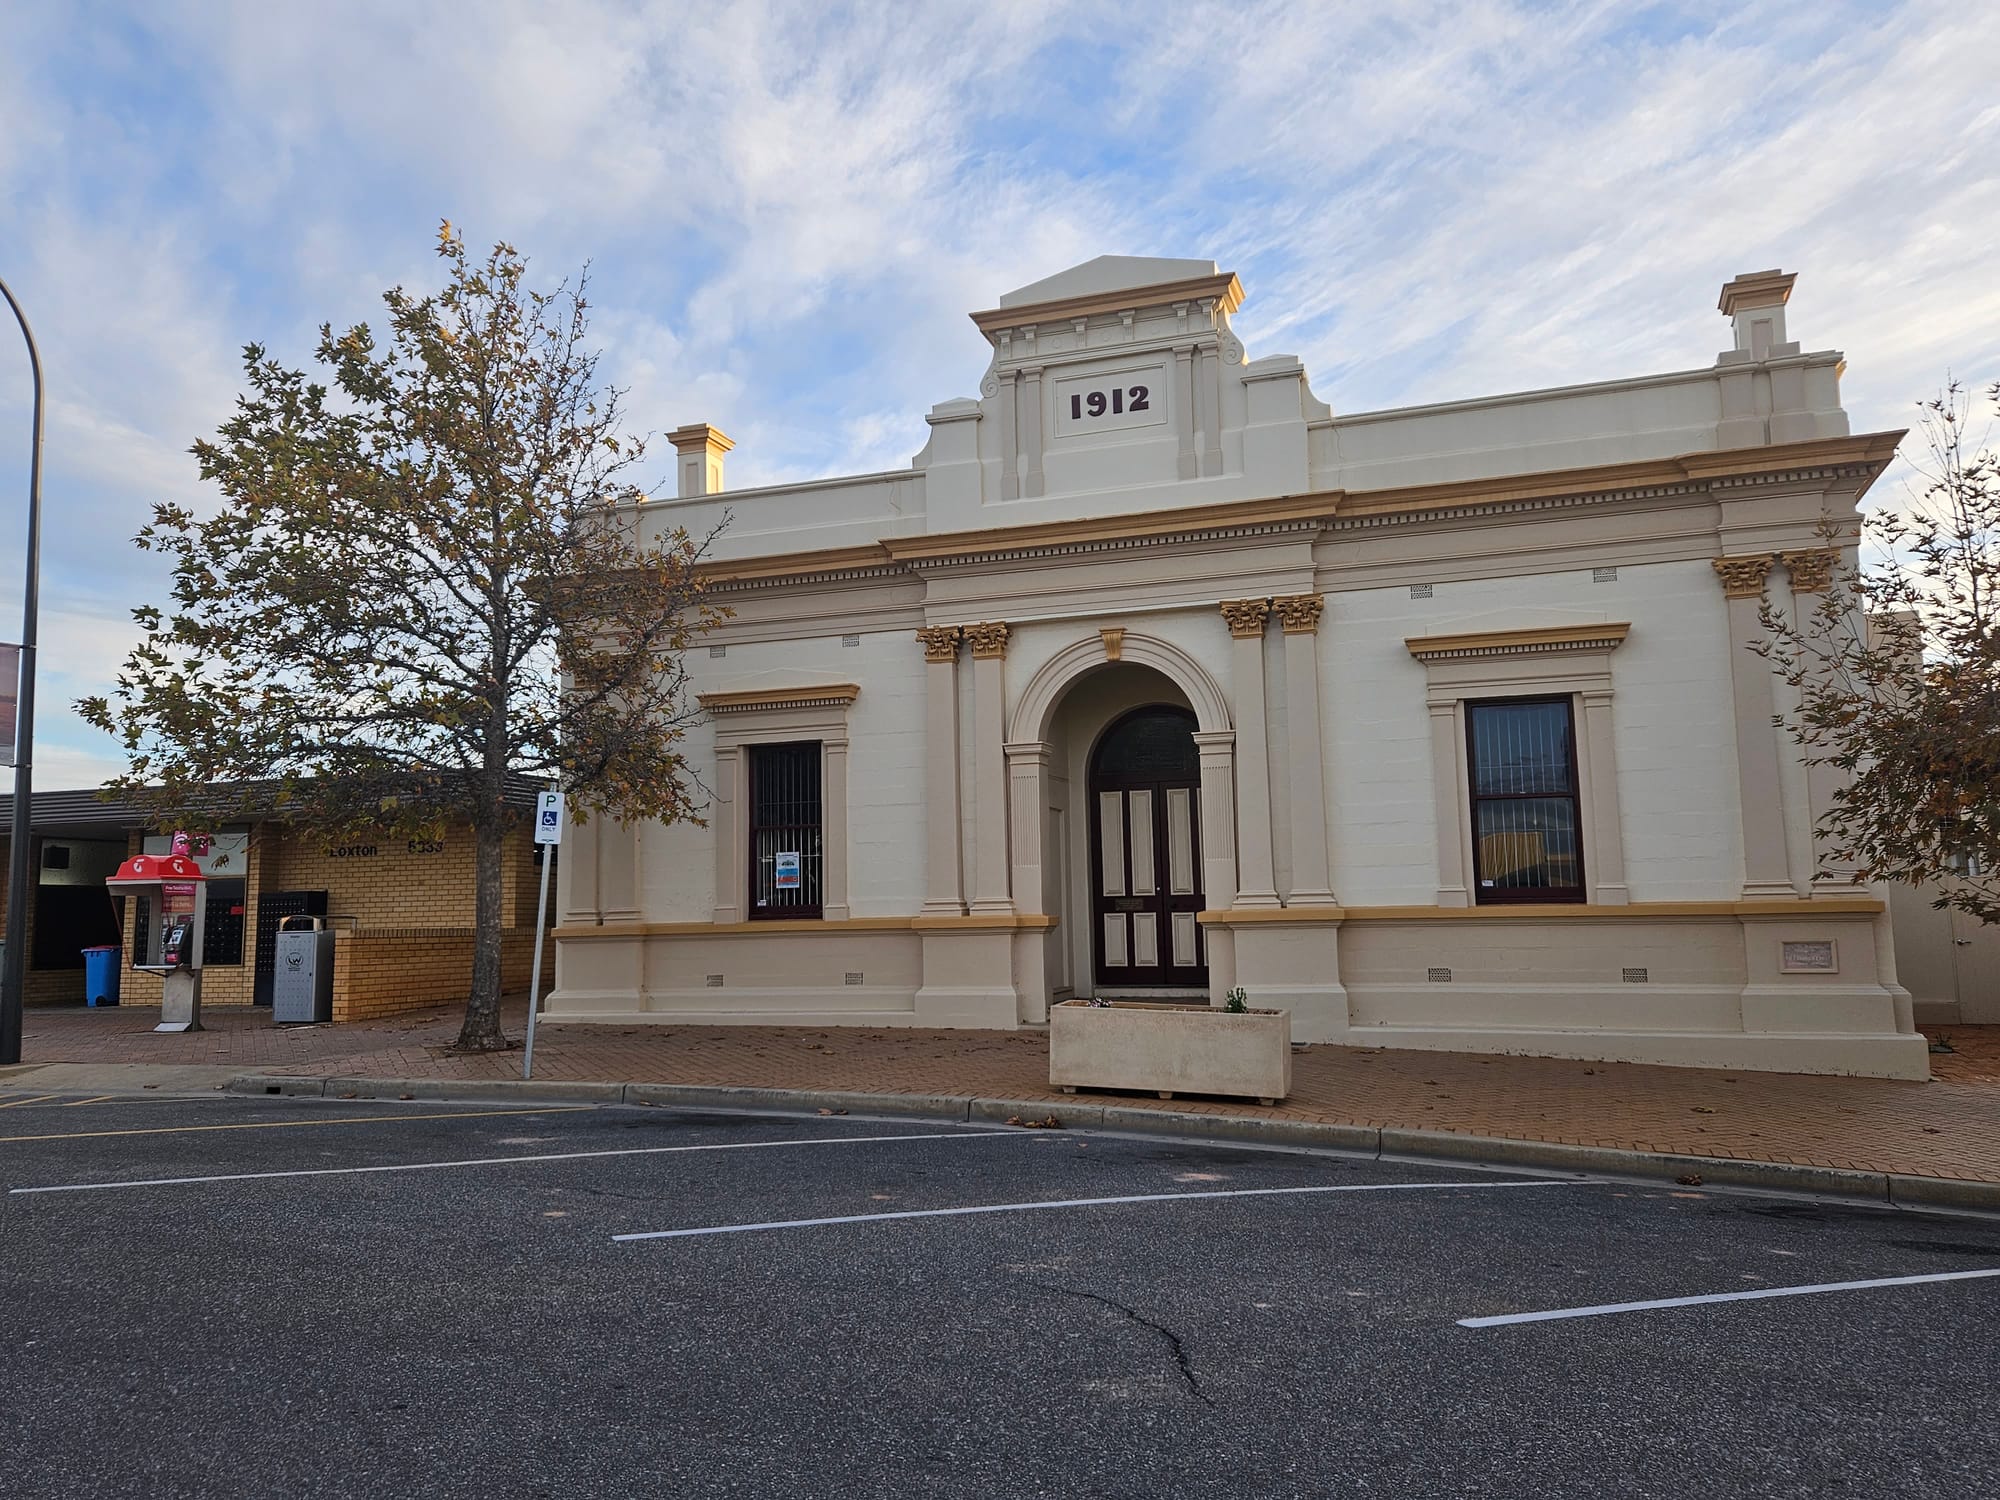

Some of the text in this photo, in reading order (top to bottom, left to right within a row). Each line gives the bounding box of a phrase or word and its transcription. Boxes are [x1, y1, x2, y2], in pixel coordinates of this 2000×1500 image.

[1071, 385, 1149, 420] 1912
[546, 794, 556, 807] P
[329, 845, 377, 857] Loxton
